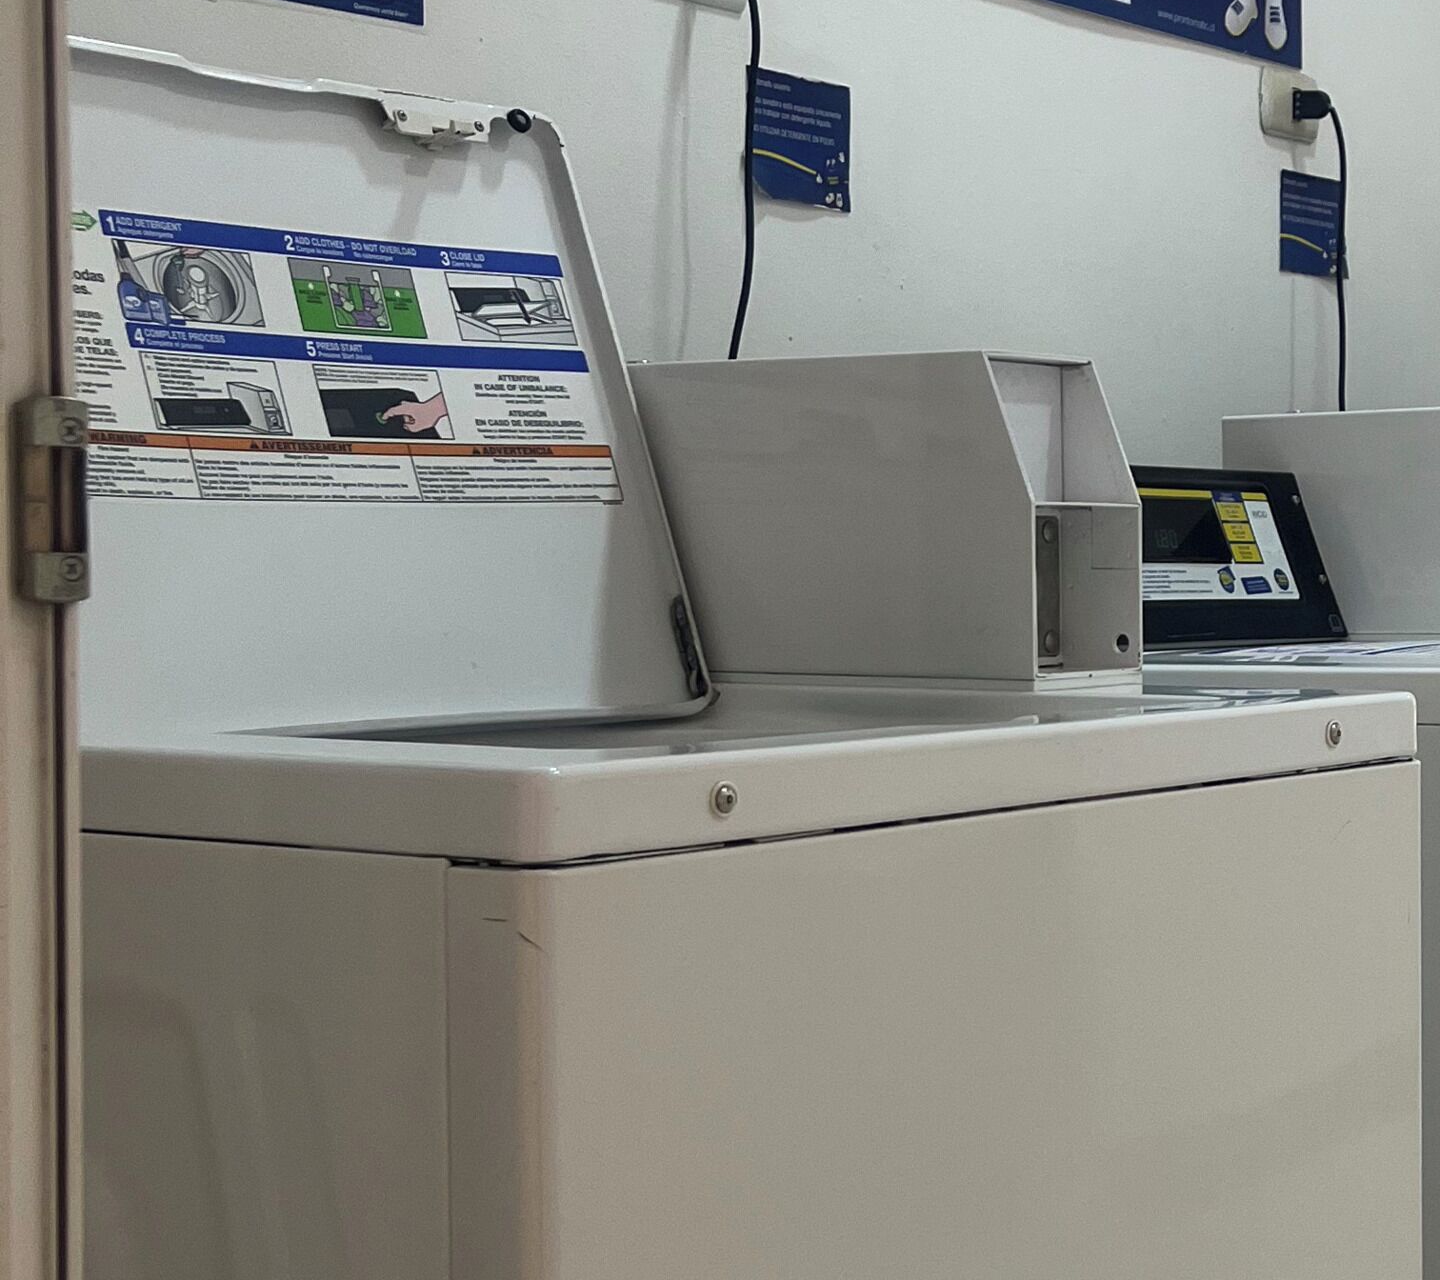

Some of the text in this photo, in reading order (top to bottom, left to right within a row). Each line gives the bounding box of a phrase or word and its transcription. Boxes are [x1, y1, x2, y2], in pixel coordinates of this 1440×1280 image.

[105, 215, 116, 232] 1
[284, 234, 295, 251] 2
[364, 243, 378, 253] NOT
[439, 251, 450, 266] 3
[134, 327, 144, 345] 4
[144, 328, 187, 340] COMPLETE
[305, 341, 317, 357] 5
